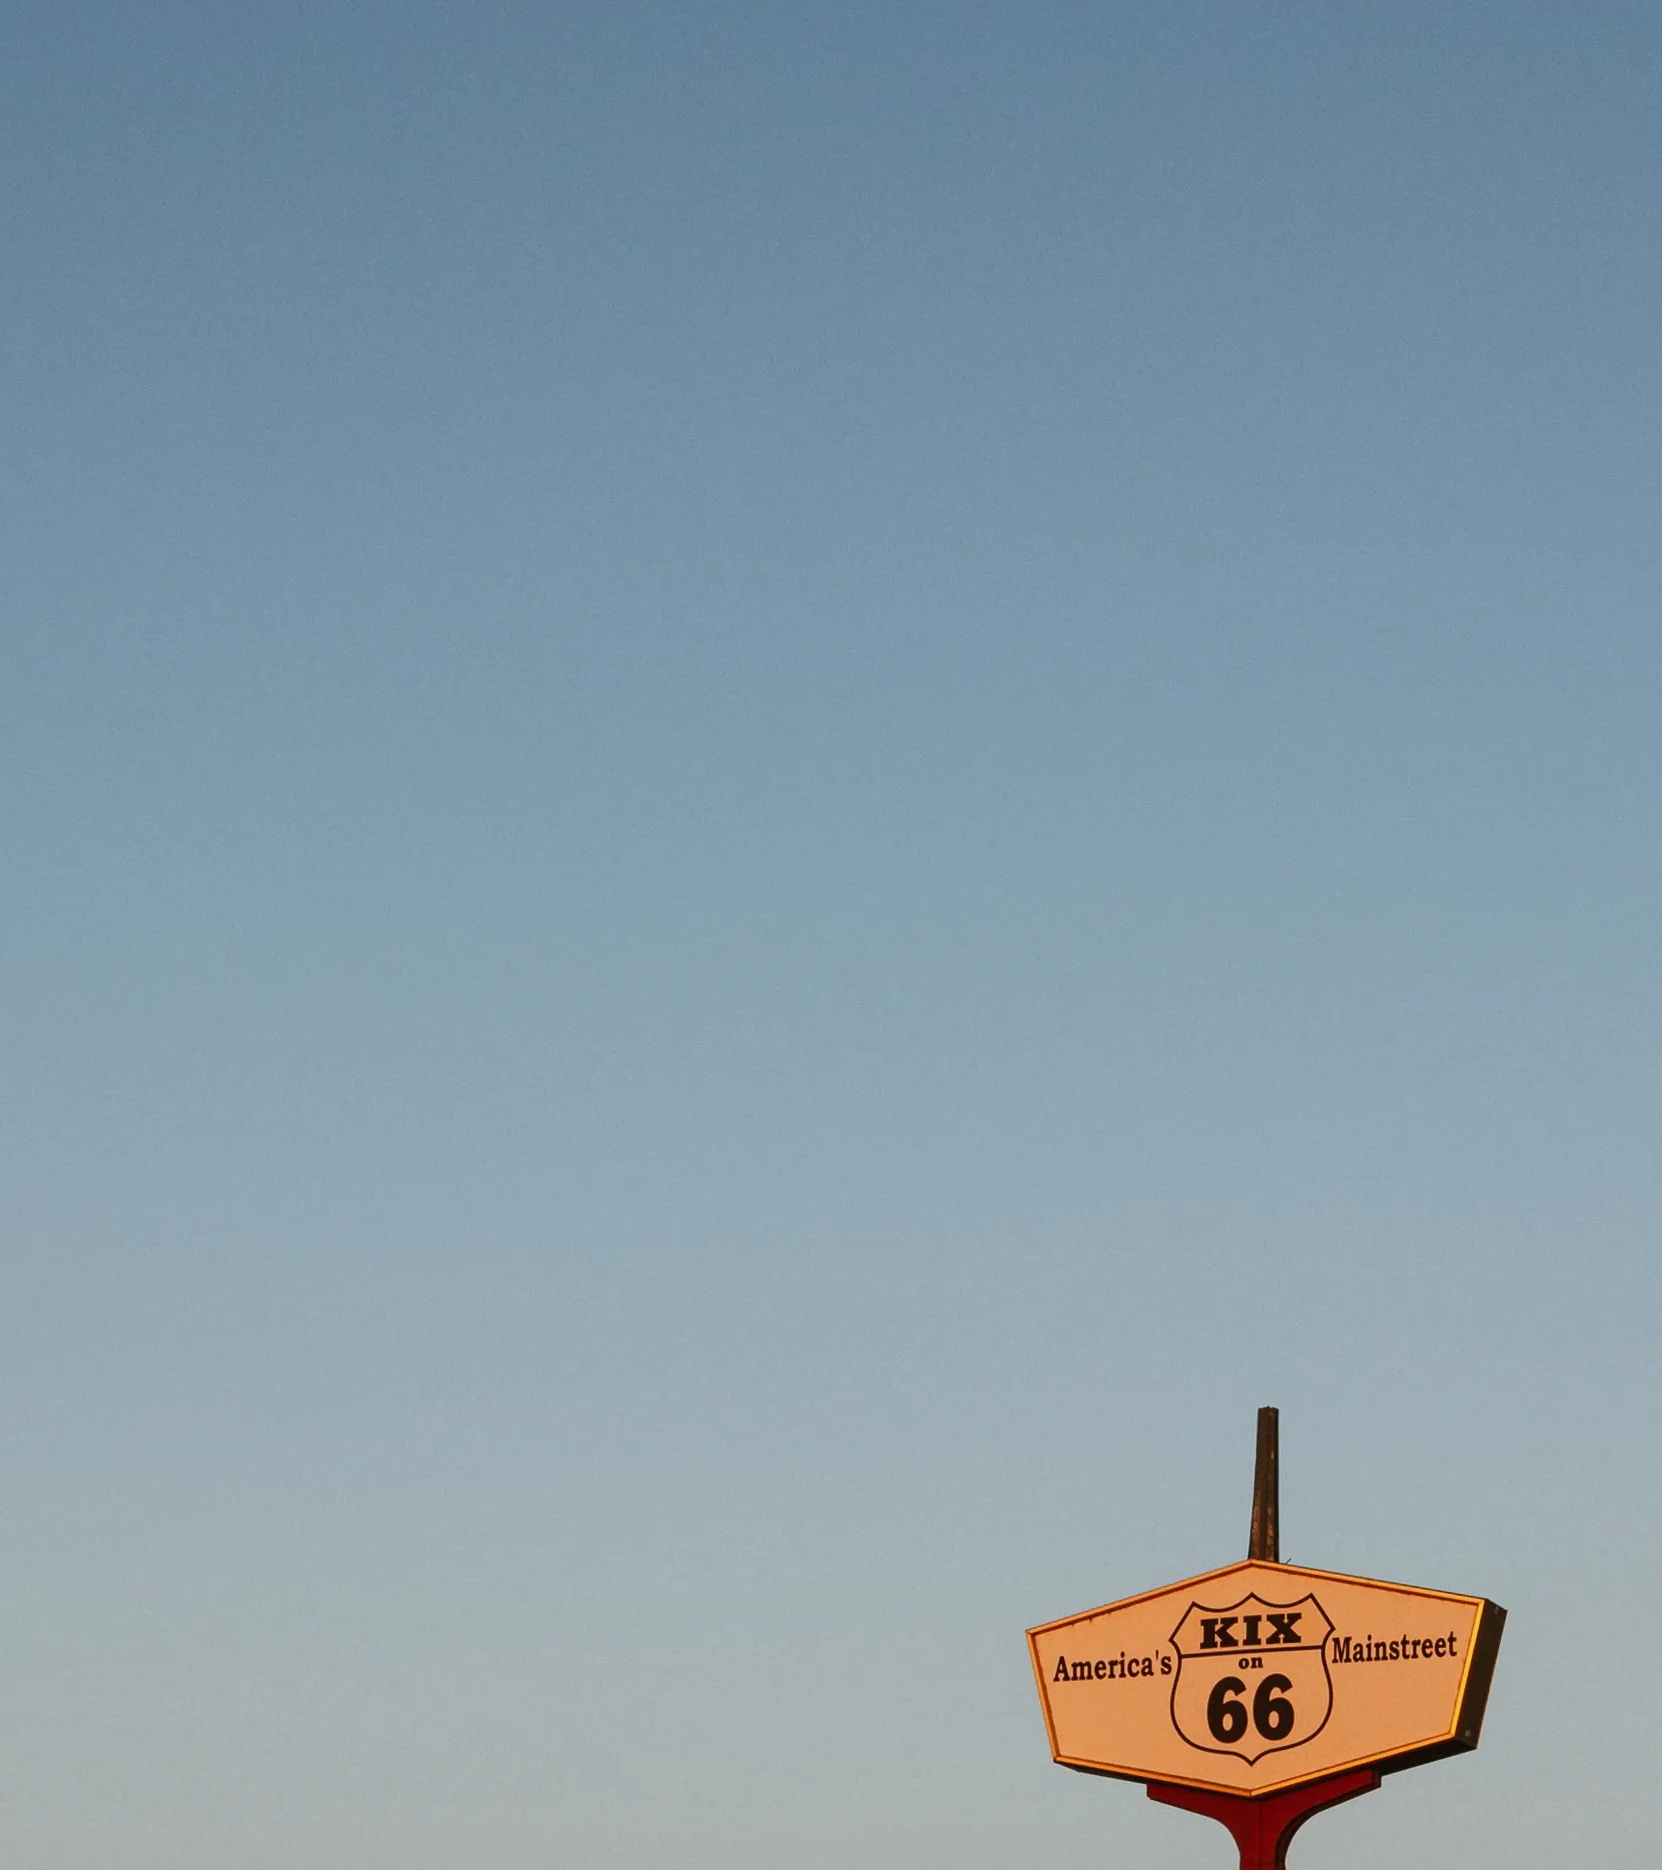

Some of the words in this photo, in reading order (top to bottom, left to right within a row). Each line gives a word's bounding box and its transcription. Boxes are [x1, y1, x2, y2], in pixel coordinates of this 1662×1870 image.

[1199, 1612, 1302, 1649] KIX
[1053, 1650, 1173, 1682] America's
[1332, 1631, 1458, 1664] Mainstreet
[1238, 1656, 1263, 1671] on
[1207, 1673, 1295, 1744] 66
